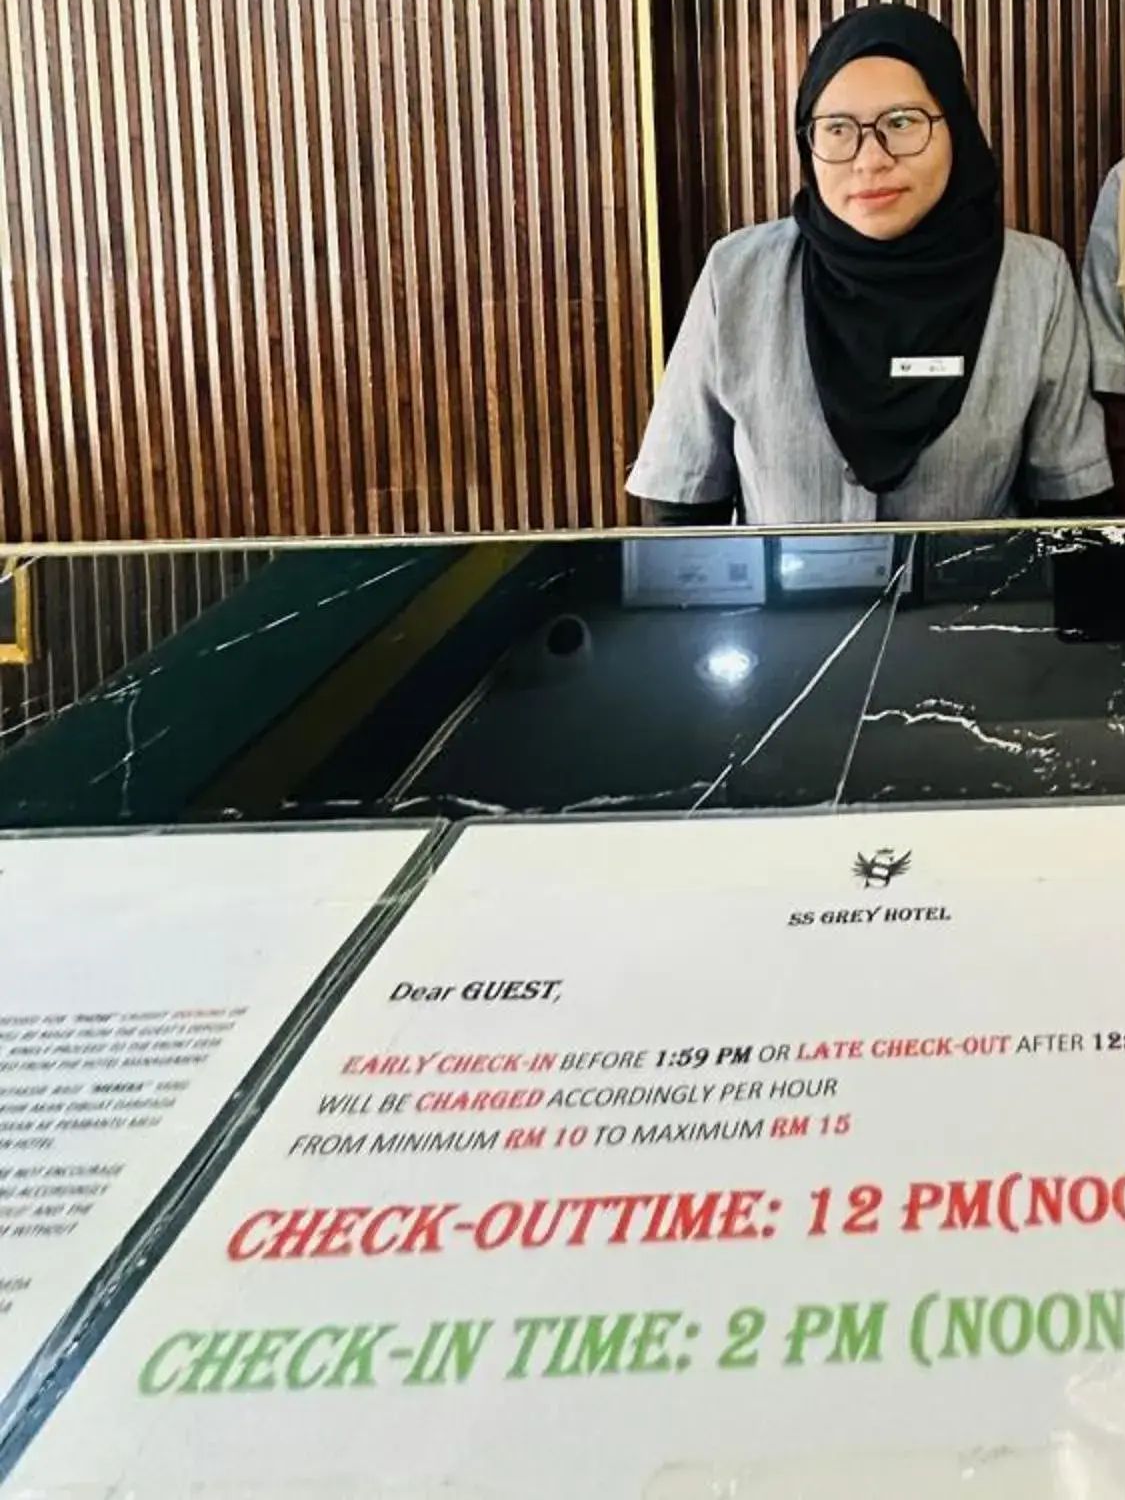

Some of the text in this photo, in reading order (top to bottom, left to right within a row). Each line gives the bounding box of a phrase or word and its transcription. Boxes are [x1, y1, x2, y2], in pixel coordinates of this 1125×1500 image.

[787, 905, 953, 927] SS GREY HOTEL
[389, 980, 564, 1004] Dear GUEST,
[341, 1051, 440, 1075] EARLY
[436, 1051, 559, 1074] CHECK-IN
[559, 1050, 648, 1071] BEFORE
[655, 1047, 709, 1069] 1:59
[715, 1045, 755, 1066] PM
[758, 1044, 791, 1064] OR
[796, 1041, 864, 1062] LATE
[871, 1035, 1012, 1059] CHECK-OUT
[1015, 1034, 1084, 1055] AFTER
[317, 1078, 838, 1115] WILL BE CHARGED ACCORDINGLY PER HOUR
[287, 1113, 852, 1157] FROM MINIMUM RM 10 TO MAXIMUM RM 15
[807, 1184, 883, 1238] 12
[137, 1319, 496, 1397] CHECK-IN
[503, 1310, 703, 1381] TIME:
[716, 1306, 767, 1370] 2
[783, 1301, 889, 1367] PM
